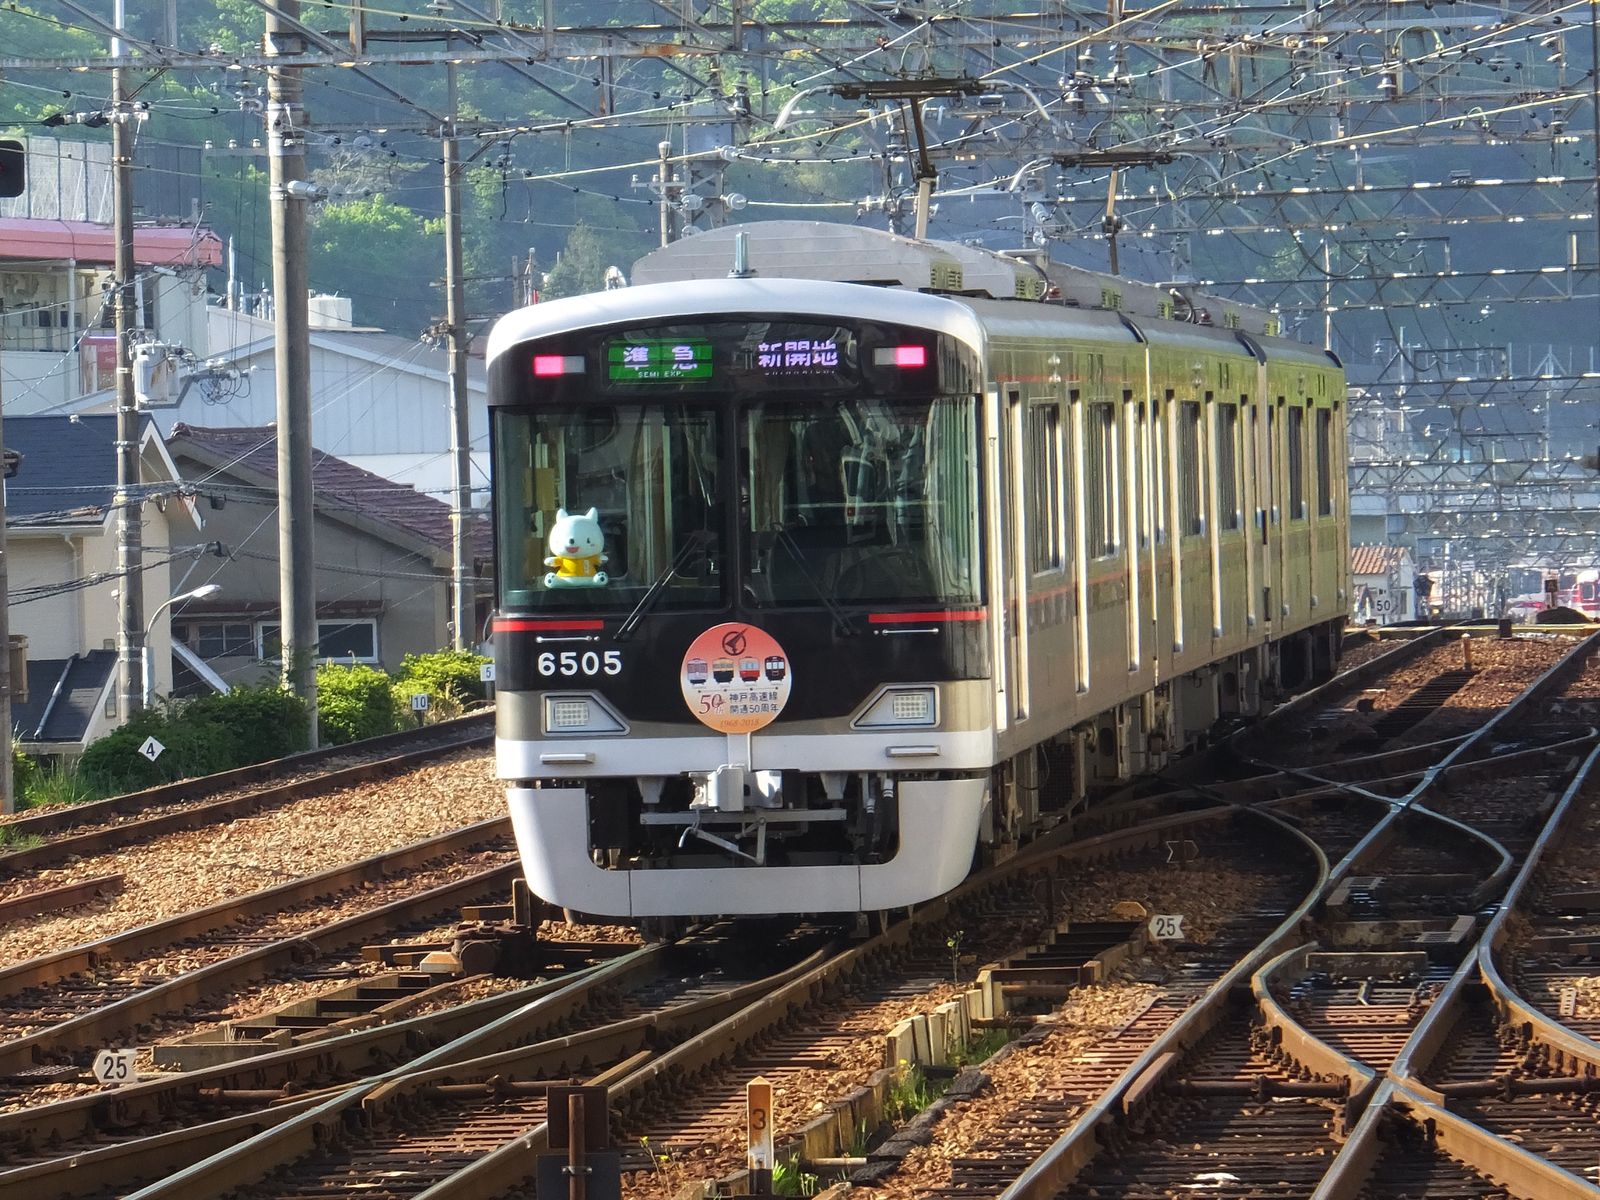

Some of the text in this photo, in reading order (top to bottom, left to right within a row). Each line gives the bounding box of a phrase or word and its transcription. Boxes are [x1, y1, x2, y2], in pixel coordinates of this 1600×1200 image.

[623, 346, 698, 371] 準急
[758, 340, 838, 367] 新開地
[1376, 600, 1391, 612] 50
[538, 650, 622, 676] 6505
[486, 666, 491, 679] 5
[414, 696, 427, 708] 10
[729, 691, 778, 702] 神戸高速線
[729, 703, 779, 714] 開通50周年
[146, 742, 156, 757] 4
[1156, 917, 1176, 937] 25
[103, 1056, 127, 1080] 25
[752, 1108, 766, 1130] 3
